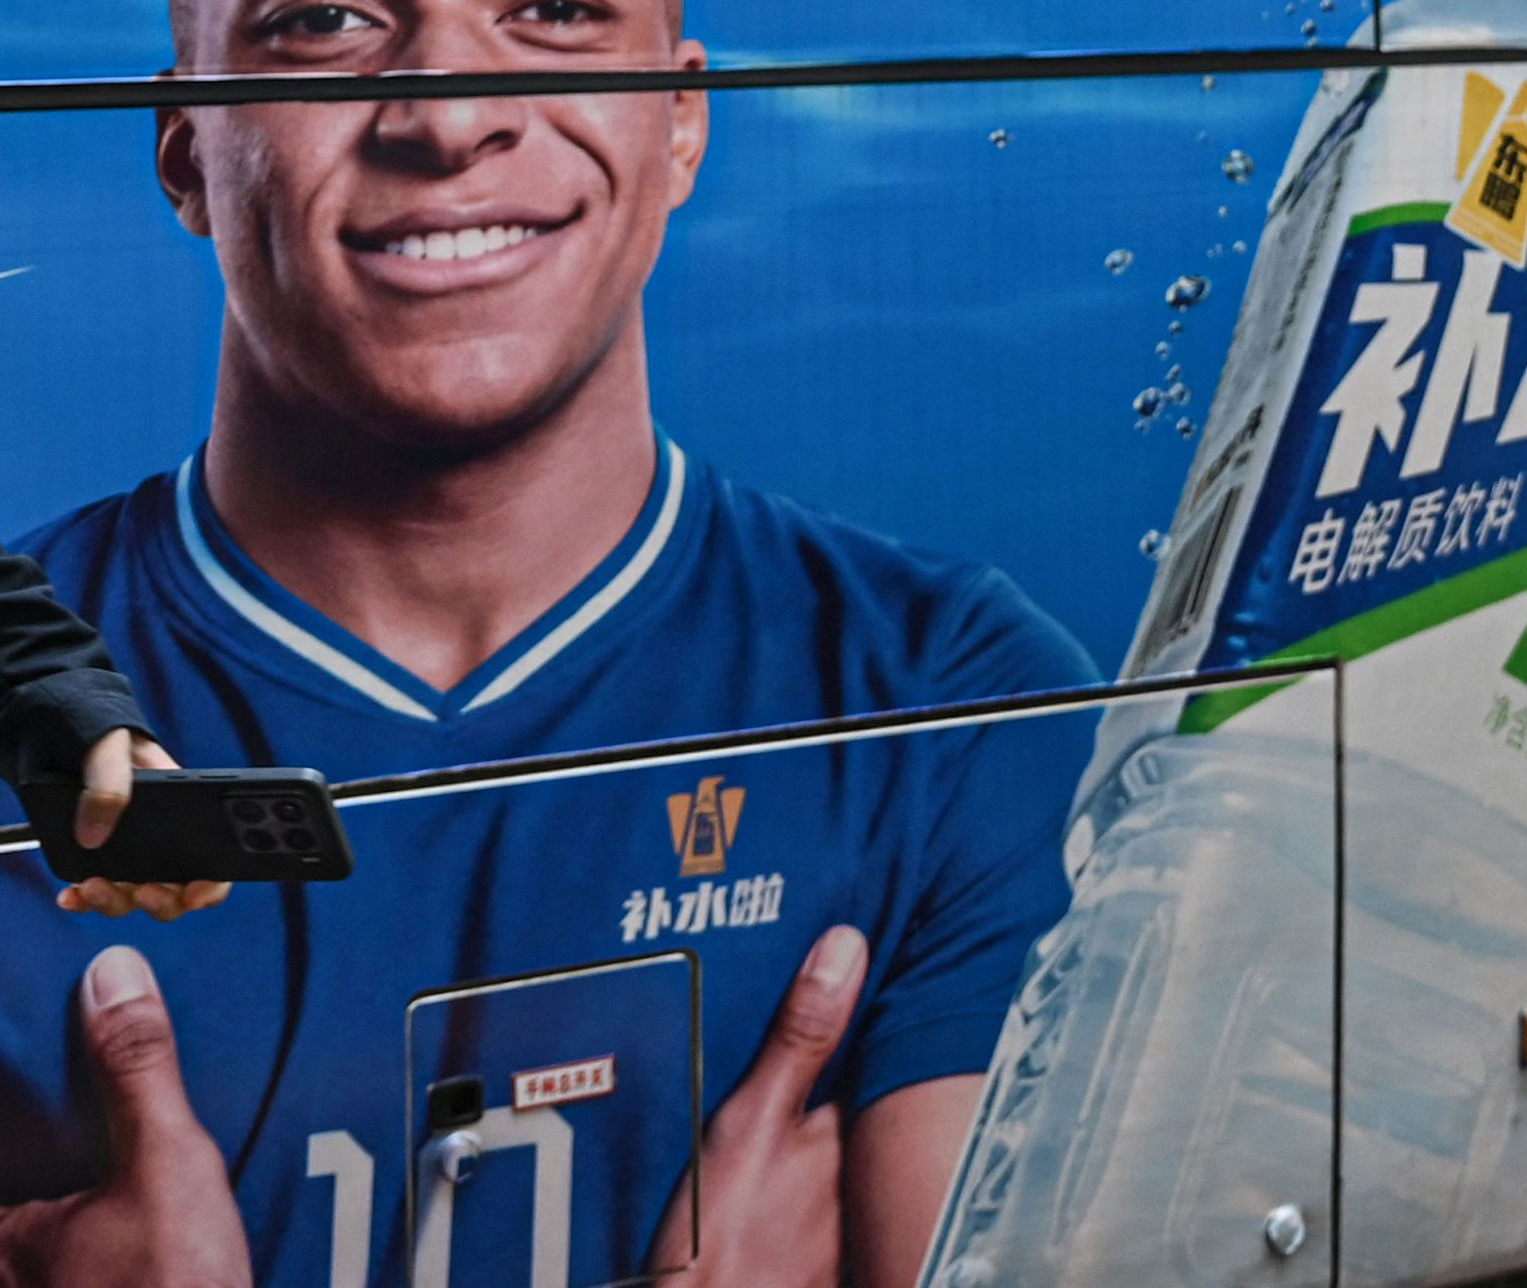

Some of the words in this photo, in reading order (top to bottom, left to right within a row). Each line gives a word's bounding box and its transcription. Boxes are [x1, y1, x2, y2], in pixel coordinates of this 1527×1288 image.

[1289, 470, 1526, 595] 电解质饮料
[620, 871, 785, 944] 补水啦
